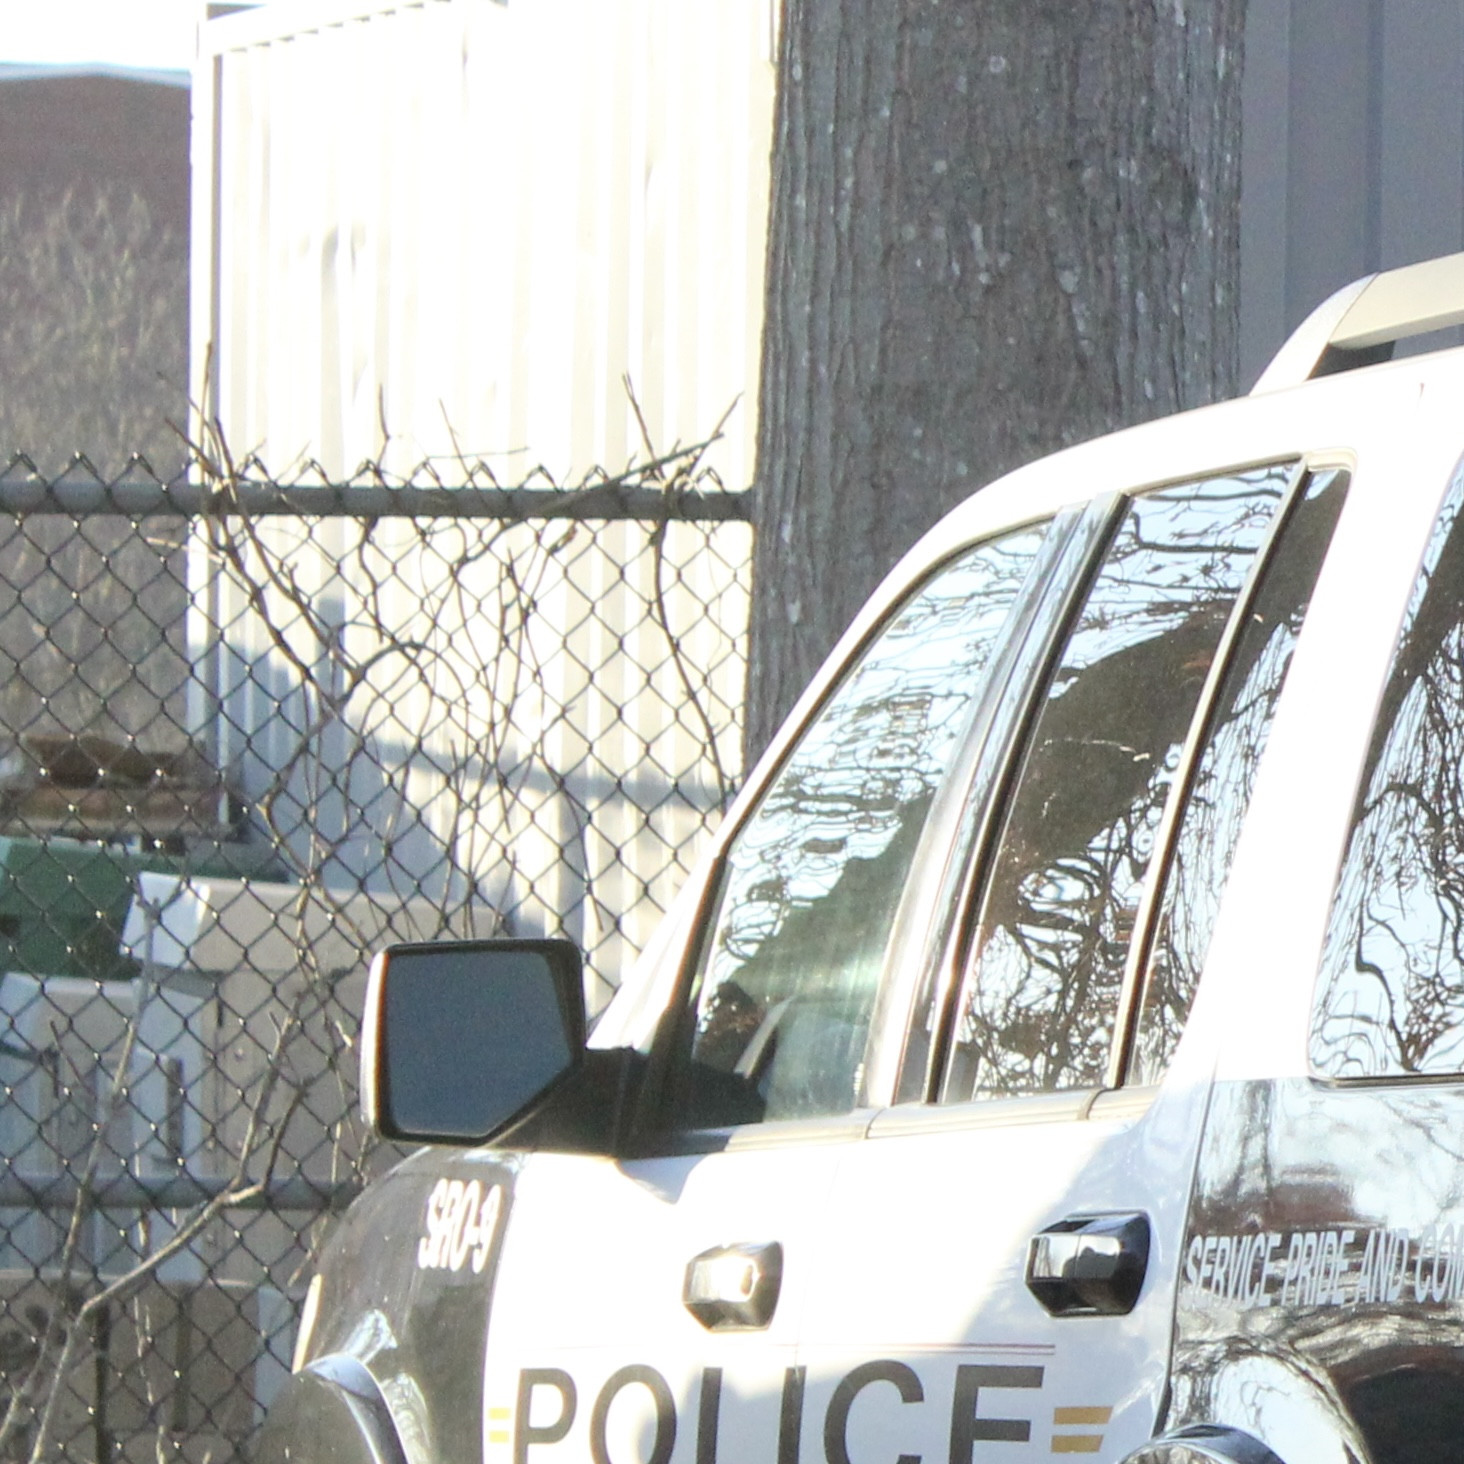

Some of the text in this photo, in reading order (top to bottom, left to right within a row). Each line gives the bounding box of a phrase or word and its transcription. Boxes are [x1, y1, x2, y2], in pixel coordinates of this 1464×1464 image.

[418, 1177, 502, 1273] SRO-9
[1186, 1232, 1282, 1307] SERVICE
[1281, 1229, 1356, 1306] PRIDE
[1355, 1227, 1409, 1303] AND
